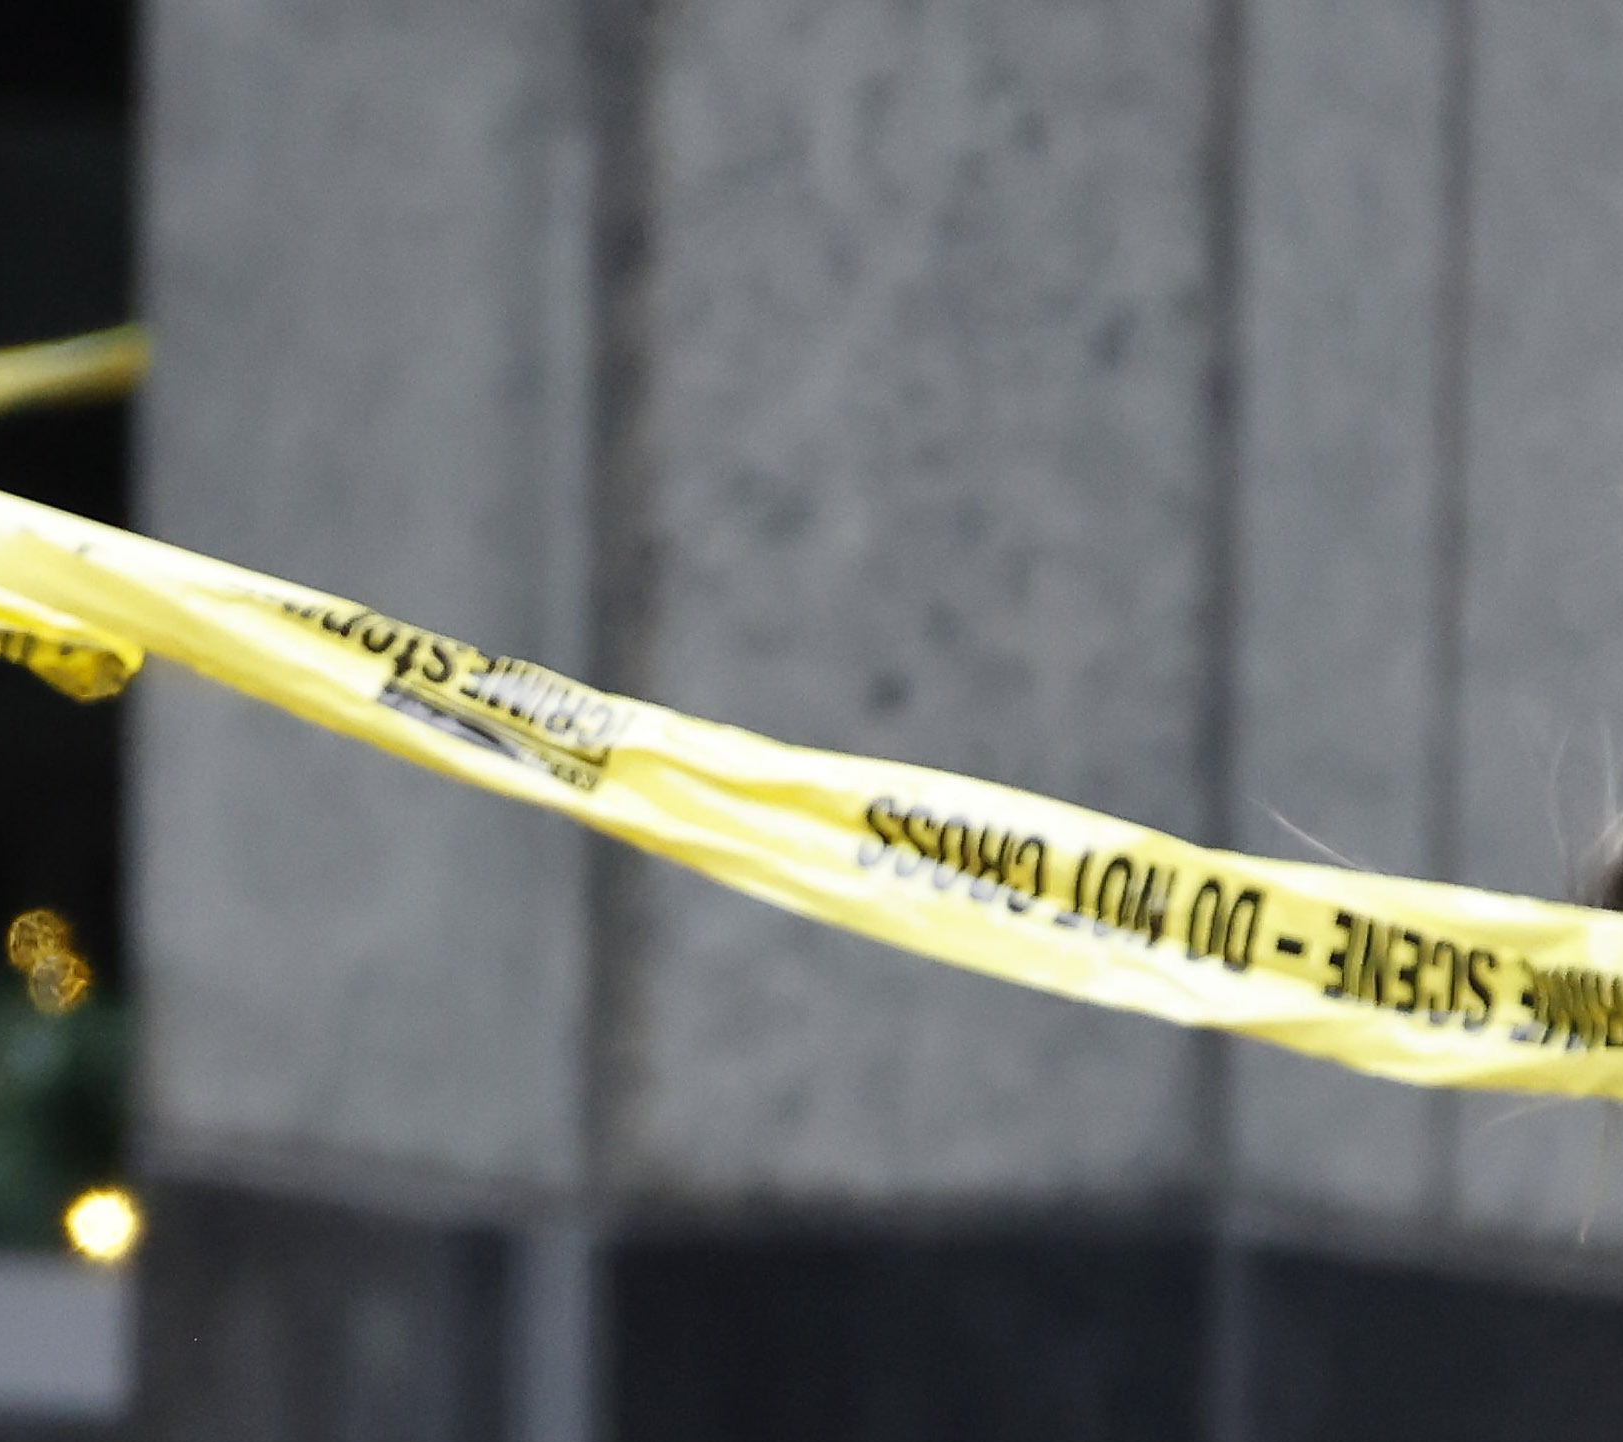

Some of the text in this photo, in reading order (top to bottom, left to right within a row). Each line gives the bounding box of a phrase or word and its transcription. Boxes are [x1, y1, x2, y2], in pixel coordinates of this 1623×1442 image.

[857, 796, 1046, 912] CROSS
[1054, 849, 1176, 947] NOT
[1186, 877, 1265, 972] DO
[1324, 909, 1498, 1032] SCENE
